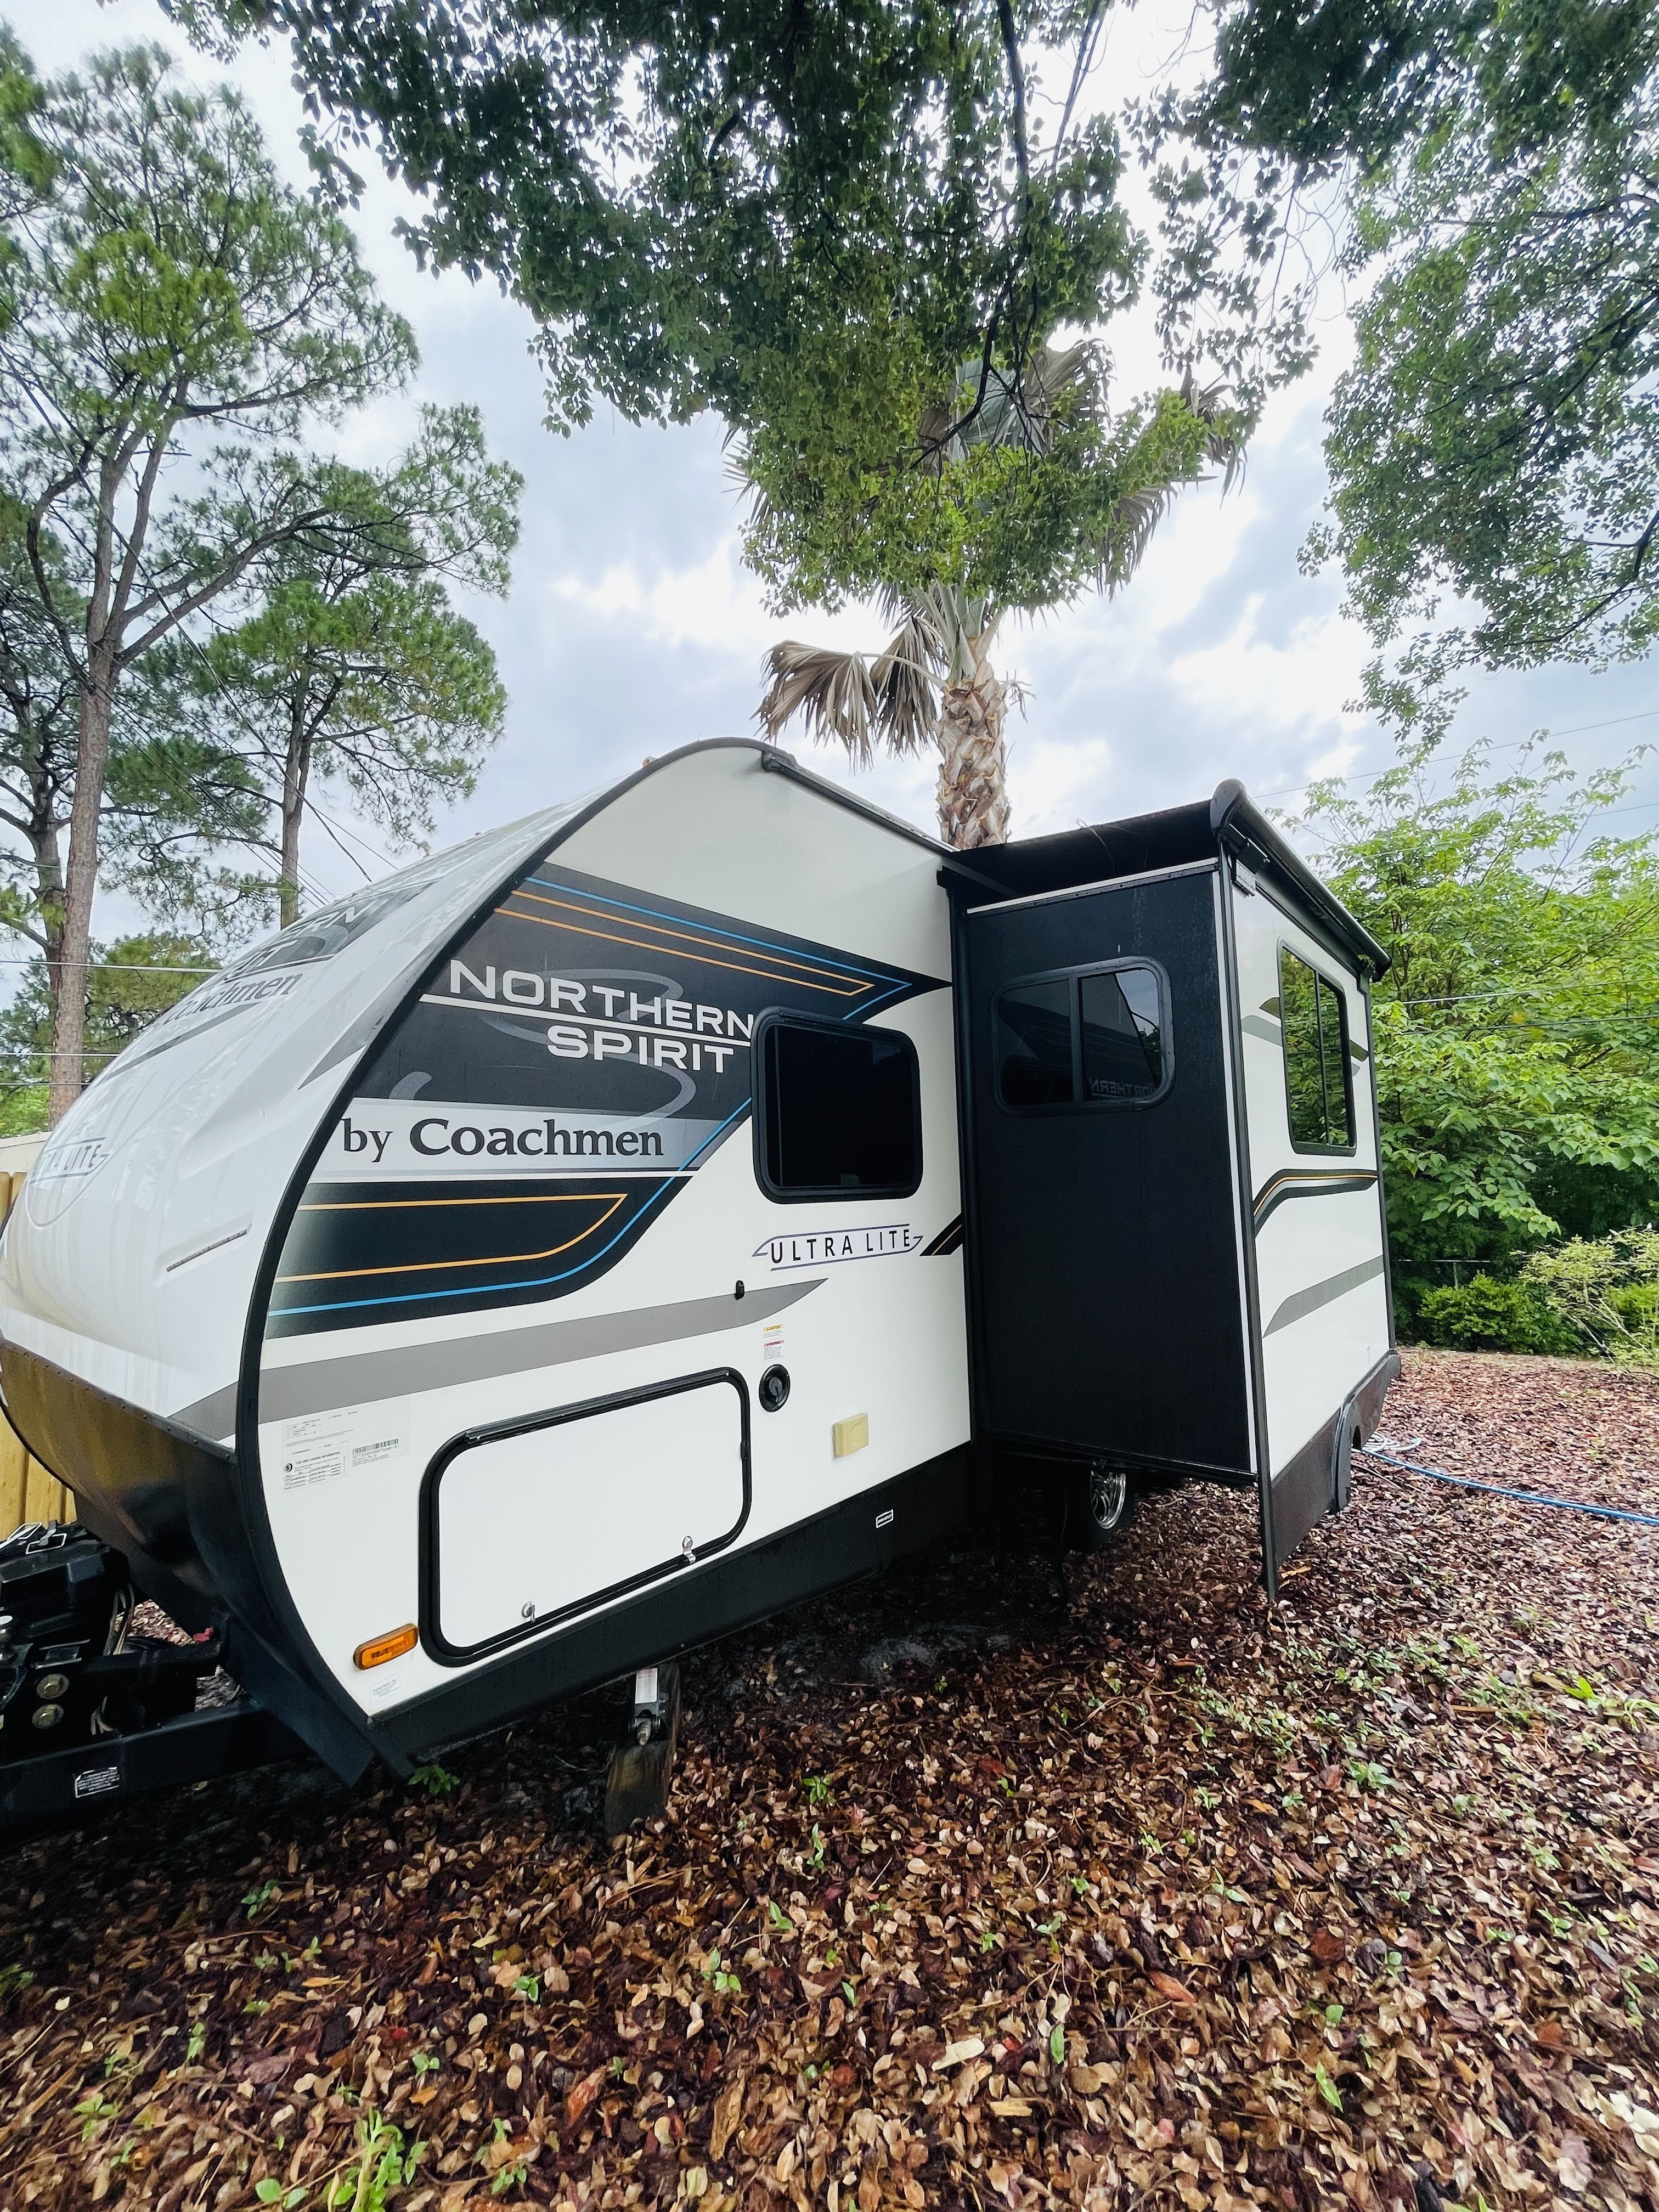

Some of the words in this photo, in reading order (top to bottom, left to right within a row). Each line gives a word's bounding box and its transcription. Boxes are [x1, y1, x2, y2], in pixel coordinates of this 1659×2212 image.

[450, 960, 754, 1039] NORTHERN
[547, 1024, 734, 1074] SPIRIT
[64, 1143, 103, 1171] LITE
[341, 1118, 393, 1162] by
[409, 1118, 664, 1156] Coachmen
[771, 1235, 853, 1264] ULTRA
[866, 1229, 910, 1252] LITE
